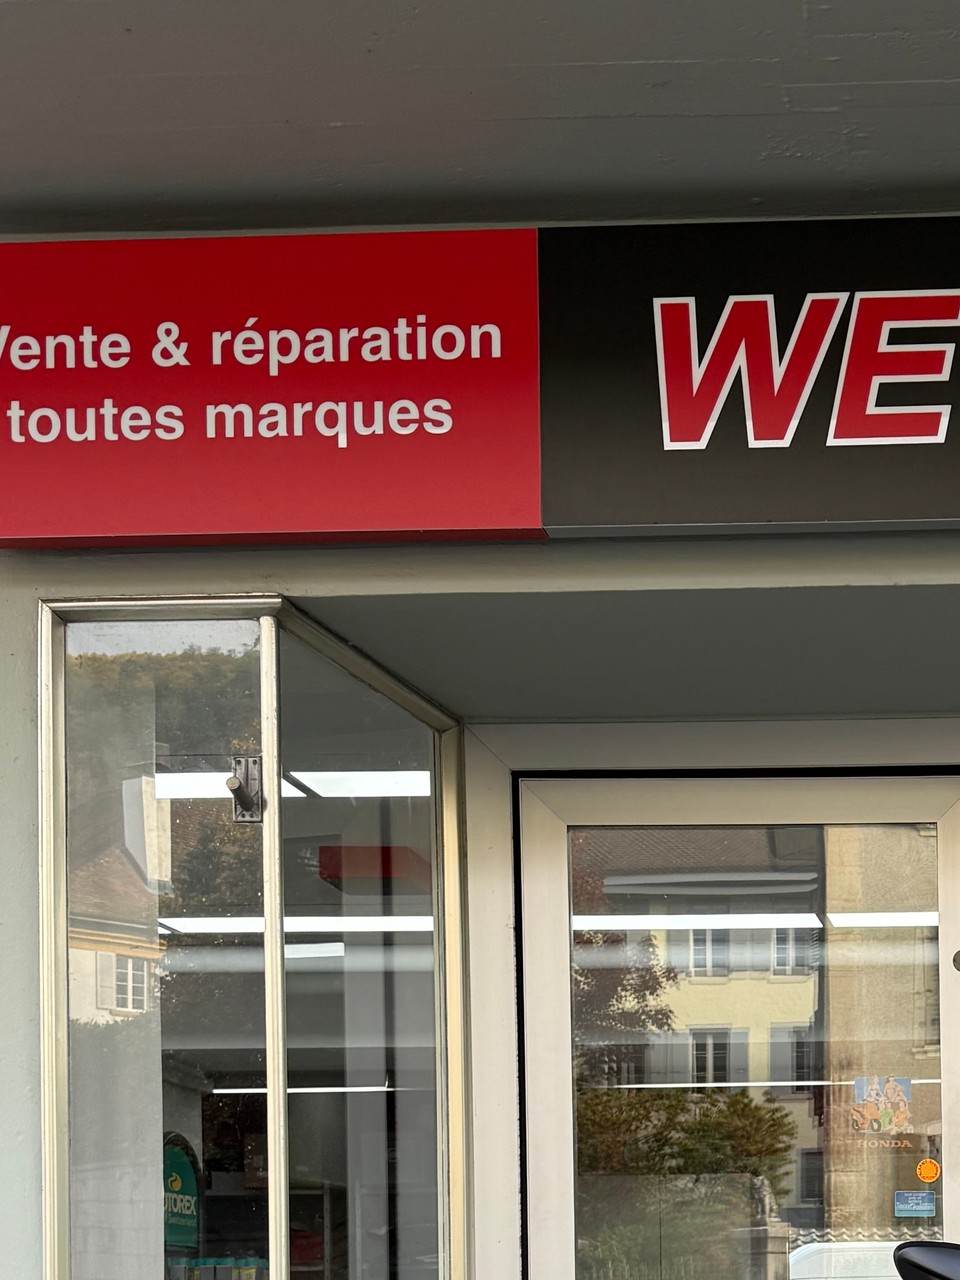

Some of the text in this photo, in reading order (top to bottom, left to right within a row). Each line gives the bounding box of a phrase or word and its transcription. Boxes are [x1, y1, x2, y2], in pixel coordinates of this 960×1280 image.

[151, 321, 191, 368] &
[211, 315, 501, 376] réparation
[7, 396, 453, 448] toutes marques
[857, 1140, 913, 1148] HONDA
[164, 1193, 196, 1215] TOREX
